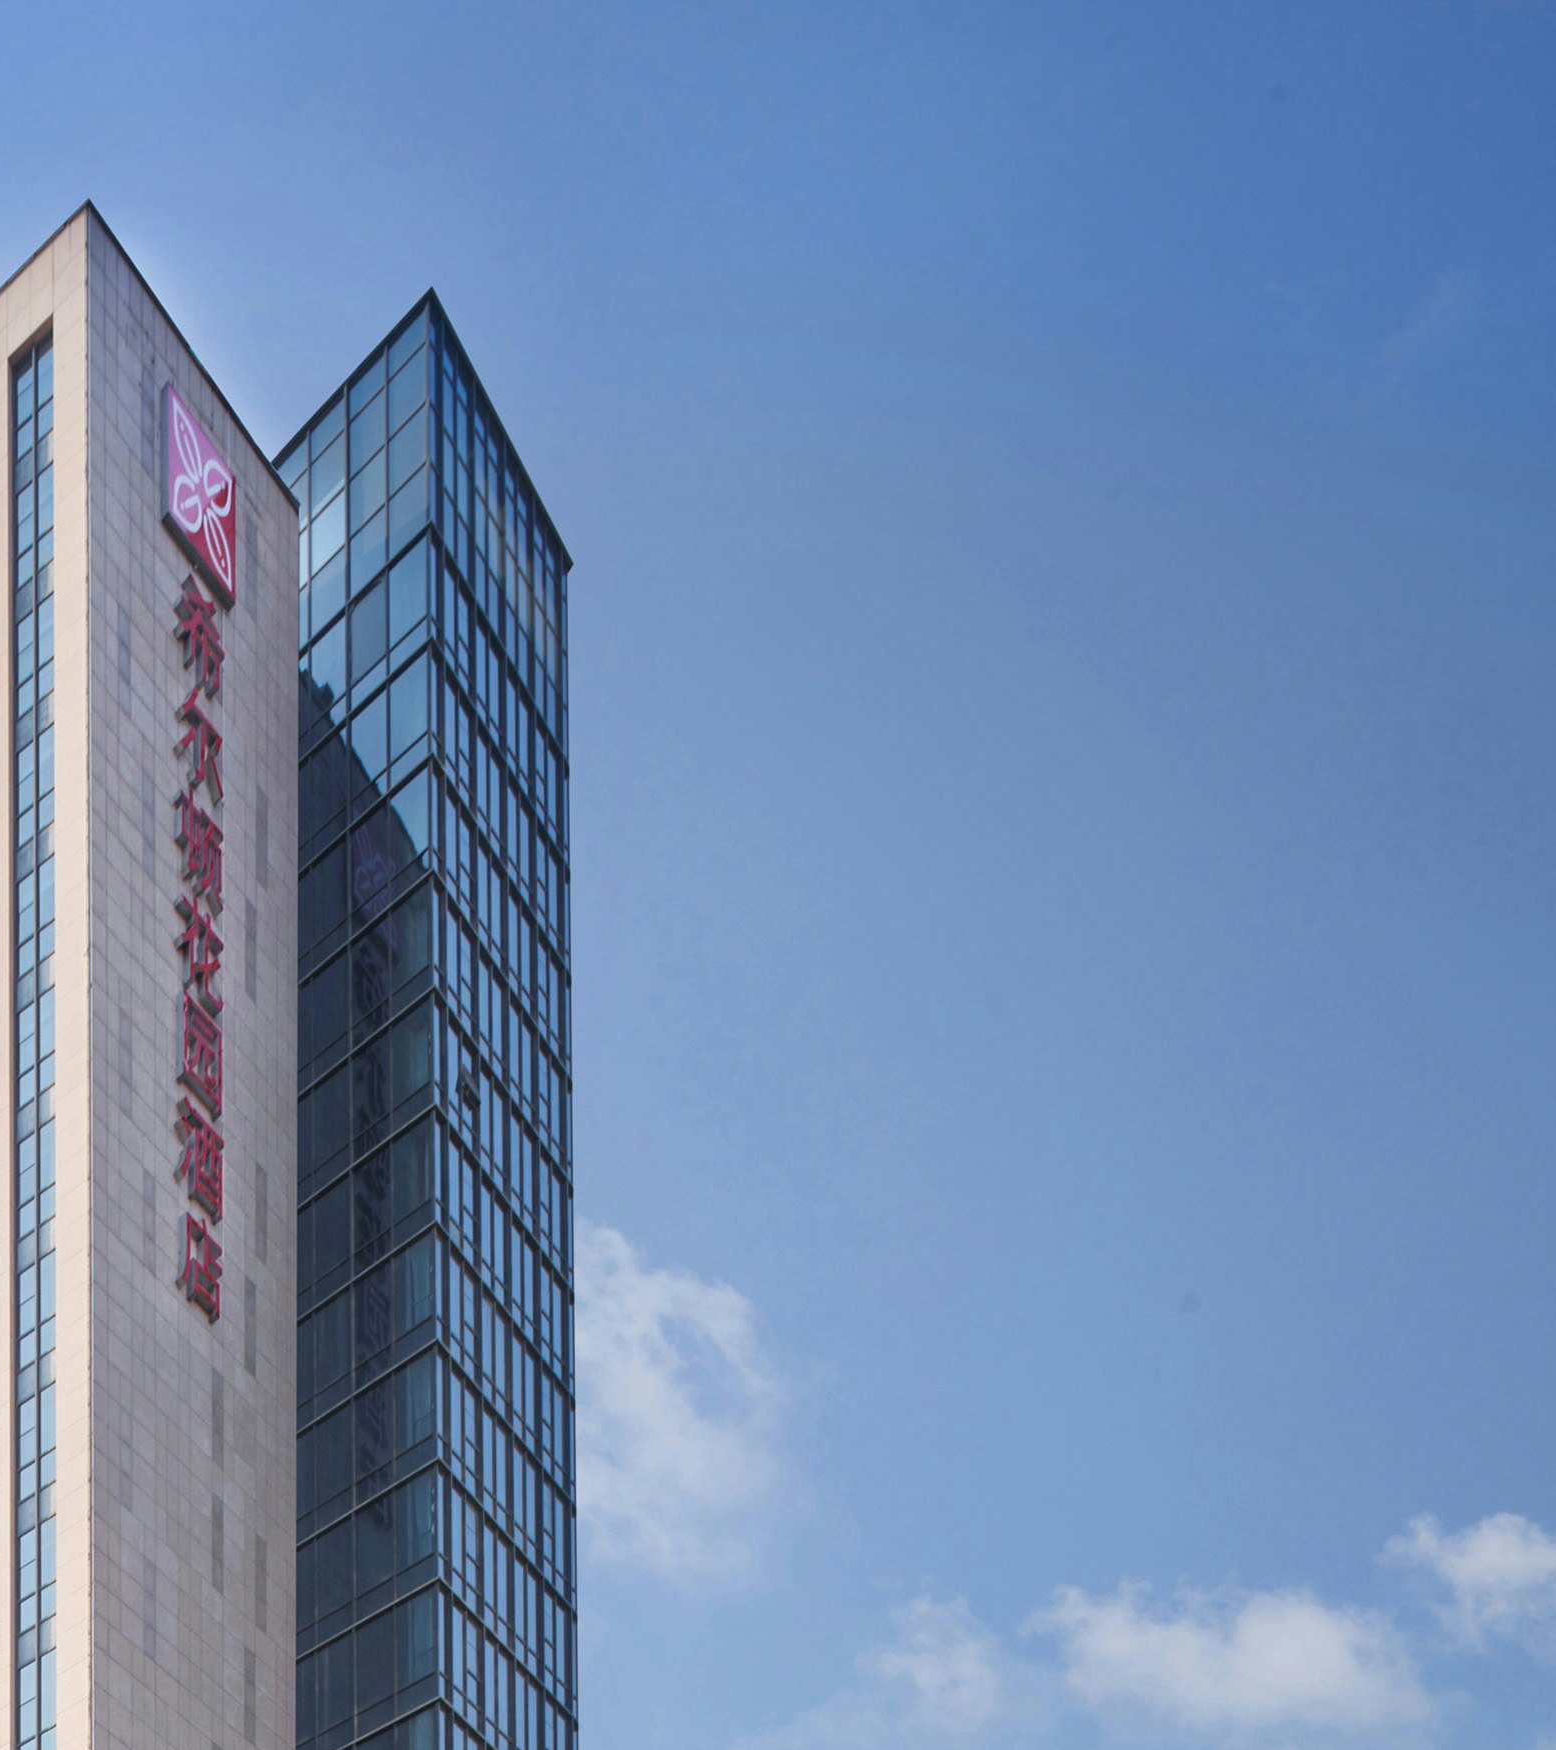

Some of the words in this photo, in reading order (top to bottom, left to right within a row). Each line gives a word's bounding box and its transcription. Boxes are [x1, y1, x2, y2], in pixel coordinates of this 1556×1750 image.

[174, 575, 224, 1323] 希尔顿花园酒店
